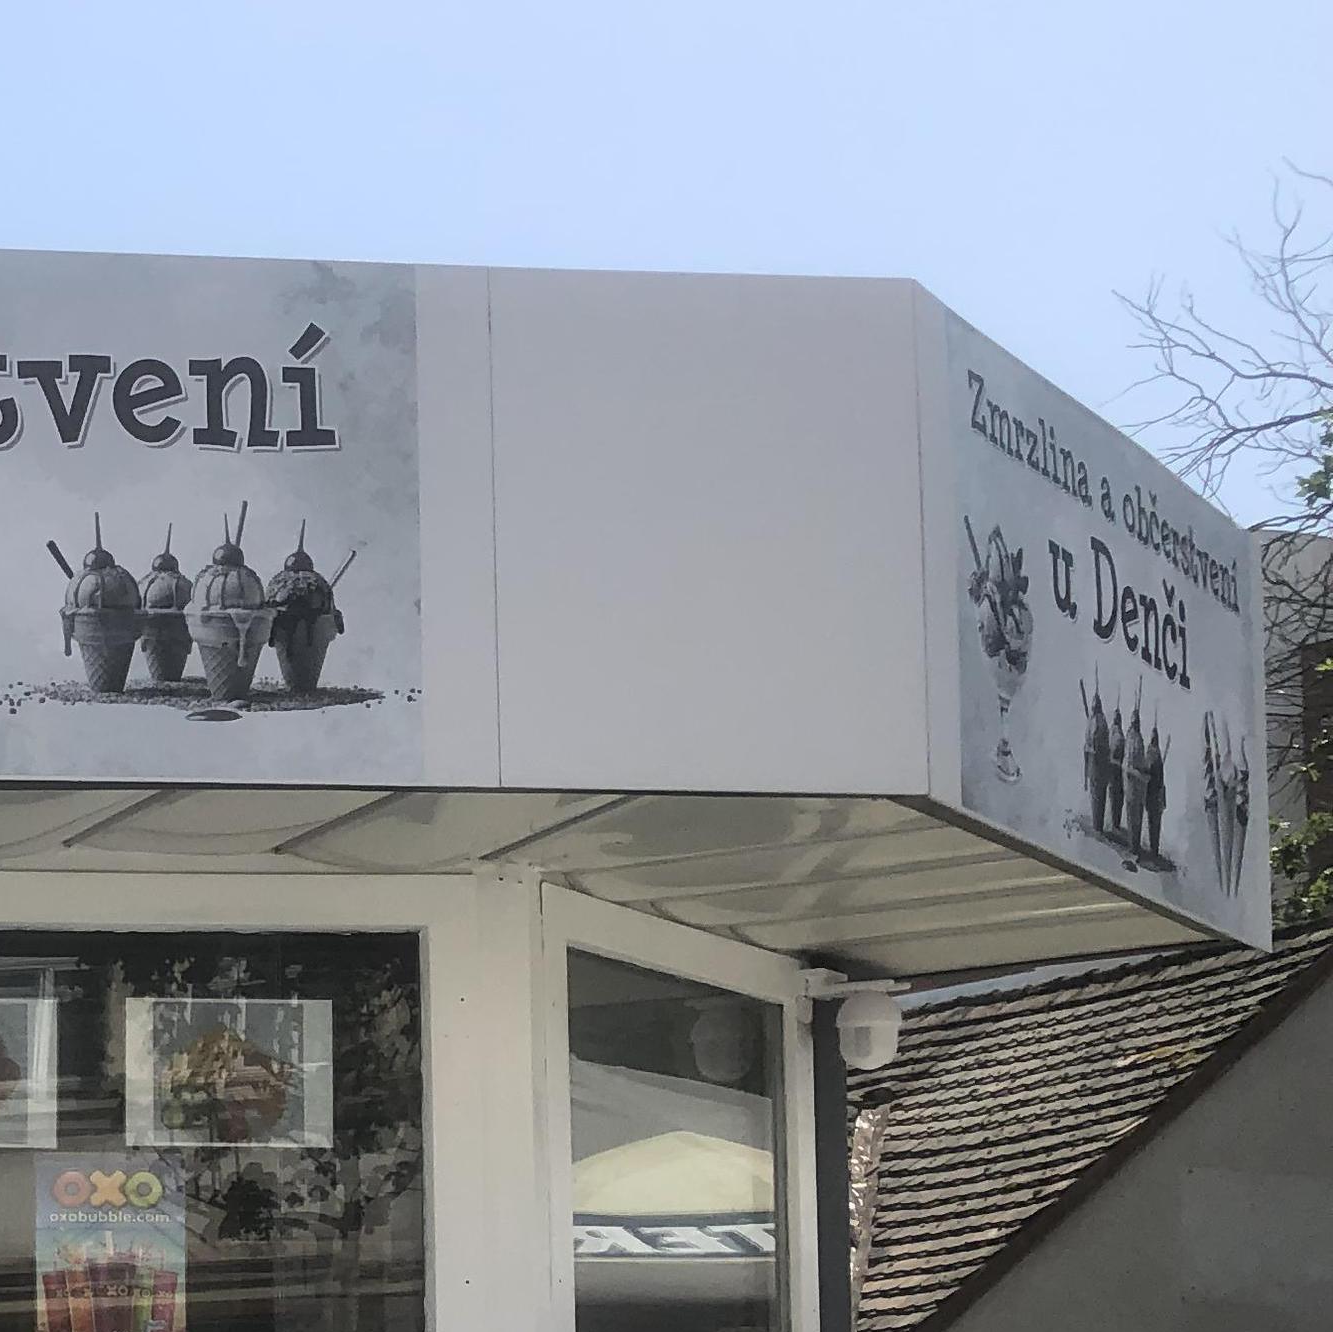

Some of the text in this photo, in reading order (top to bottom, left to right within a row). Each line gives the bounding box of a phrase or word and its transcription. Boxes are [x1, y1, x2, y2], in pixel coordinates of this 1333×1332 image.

[968, 368, 1241, 613] Zmrzlina a občerstvení
[1047, 535, 1192, 690] u Denči
[49, 1210, 170, 1223] oxobubble.com
[52, 1168, 164, 1208] OXO
